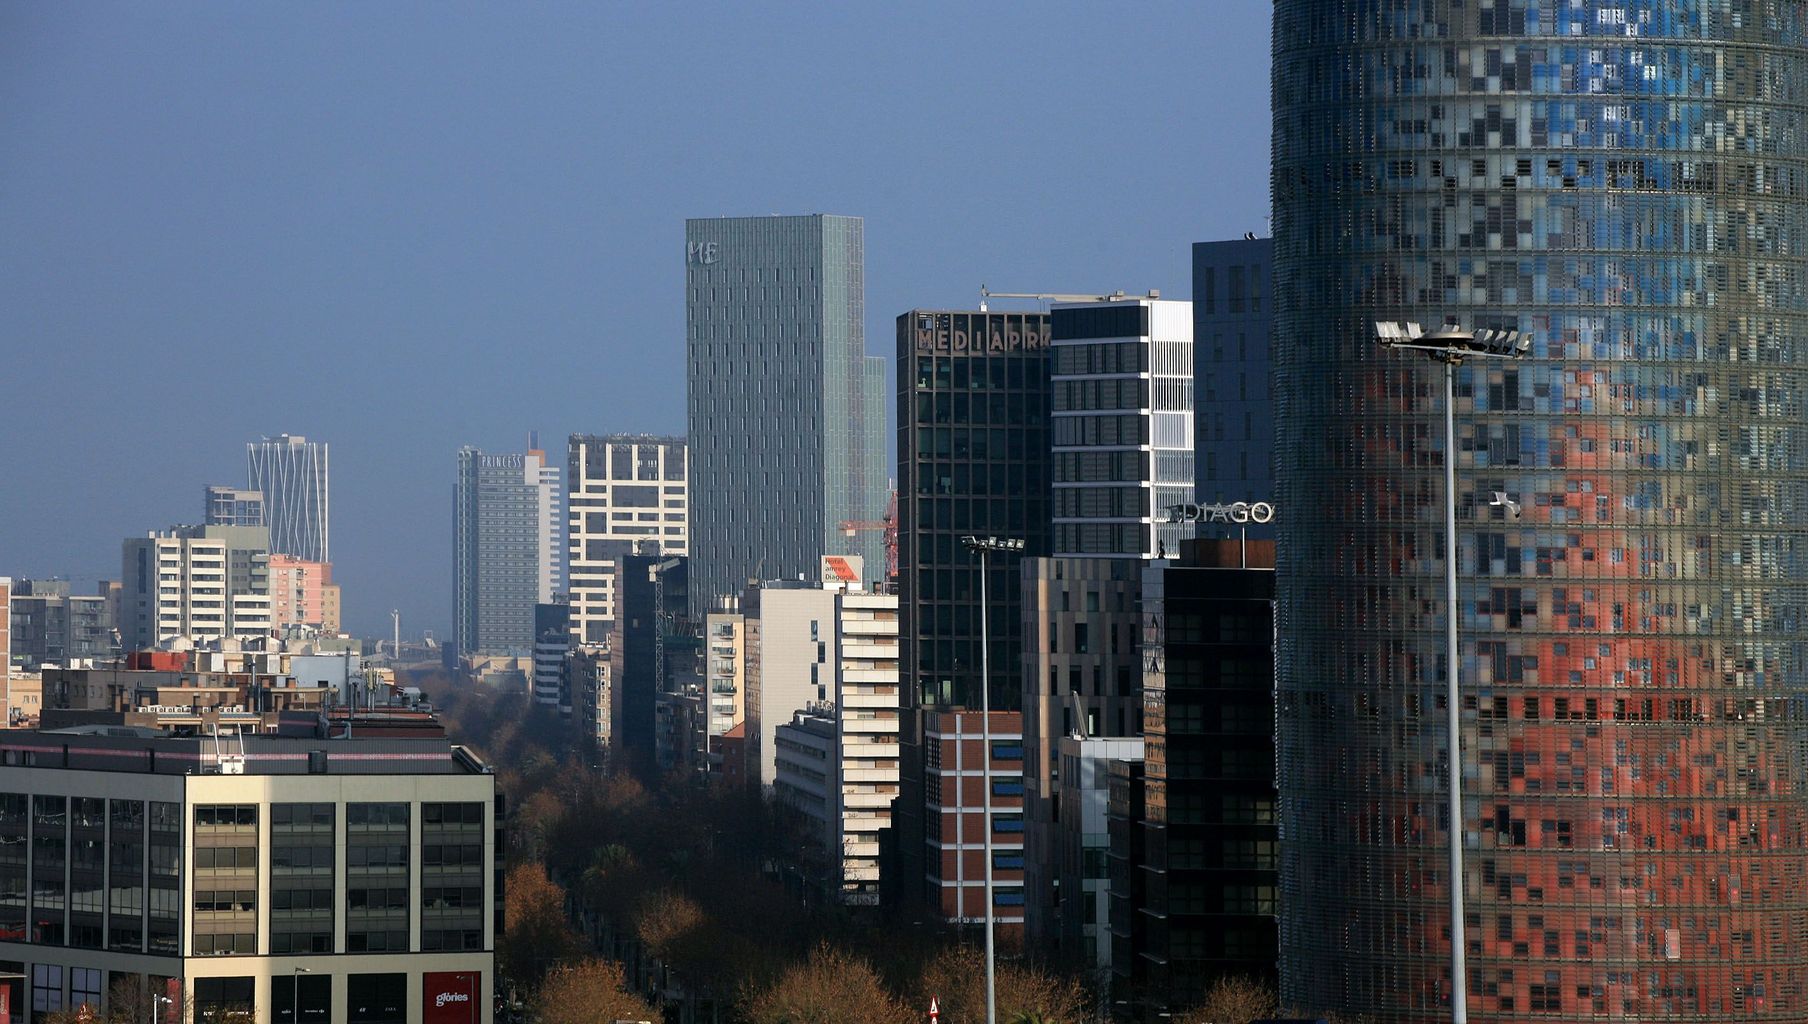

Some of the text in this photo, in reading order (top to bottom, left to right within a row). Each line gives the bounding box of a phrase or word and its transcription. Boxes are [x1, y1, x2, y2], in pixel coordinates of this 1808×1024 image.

[481, 453, 522, 468] PRINCESS
[1183, 501, 1272, 523] DIAGO
[825, 573, 855, 581] Diagonal
